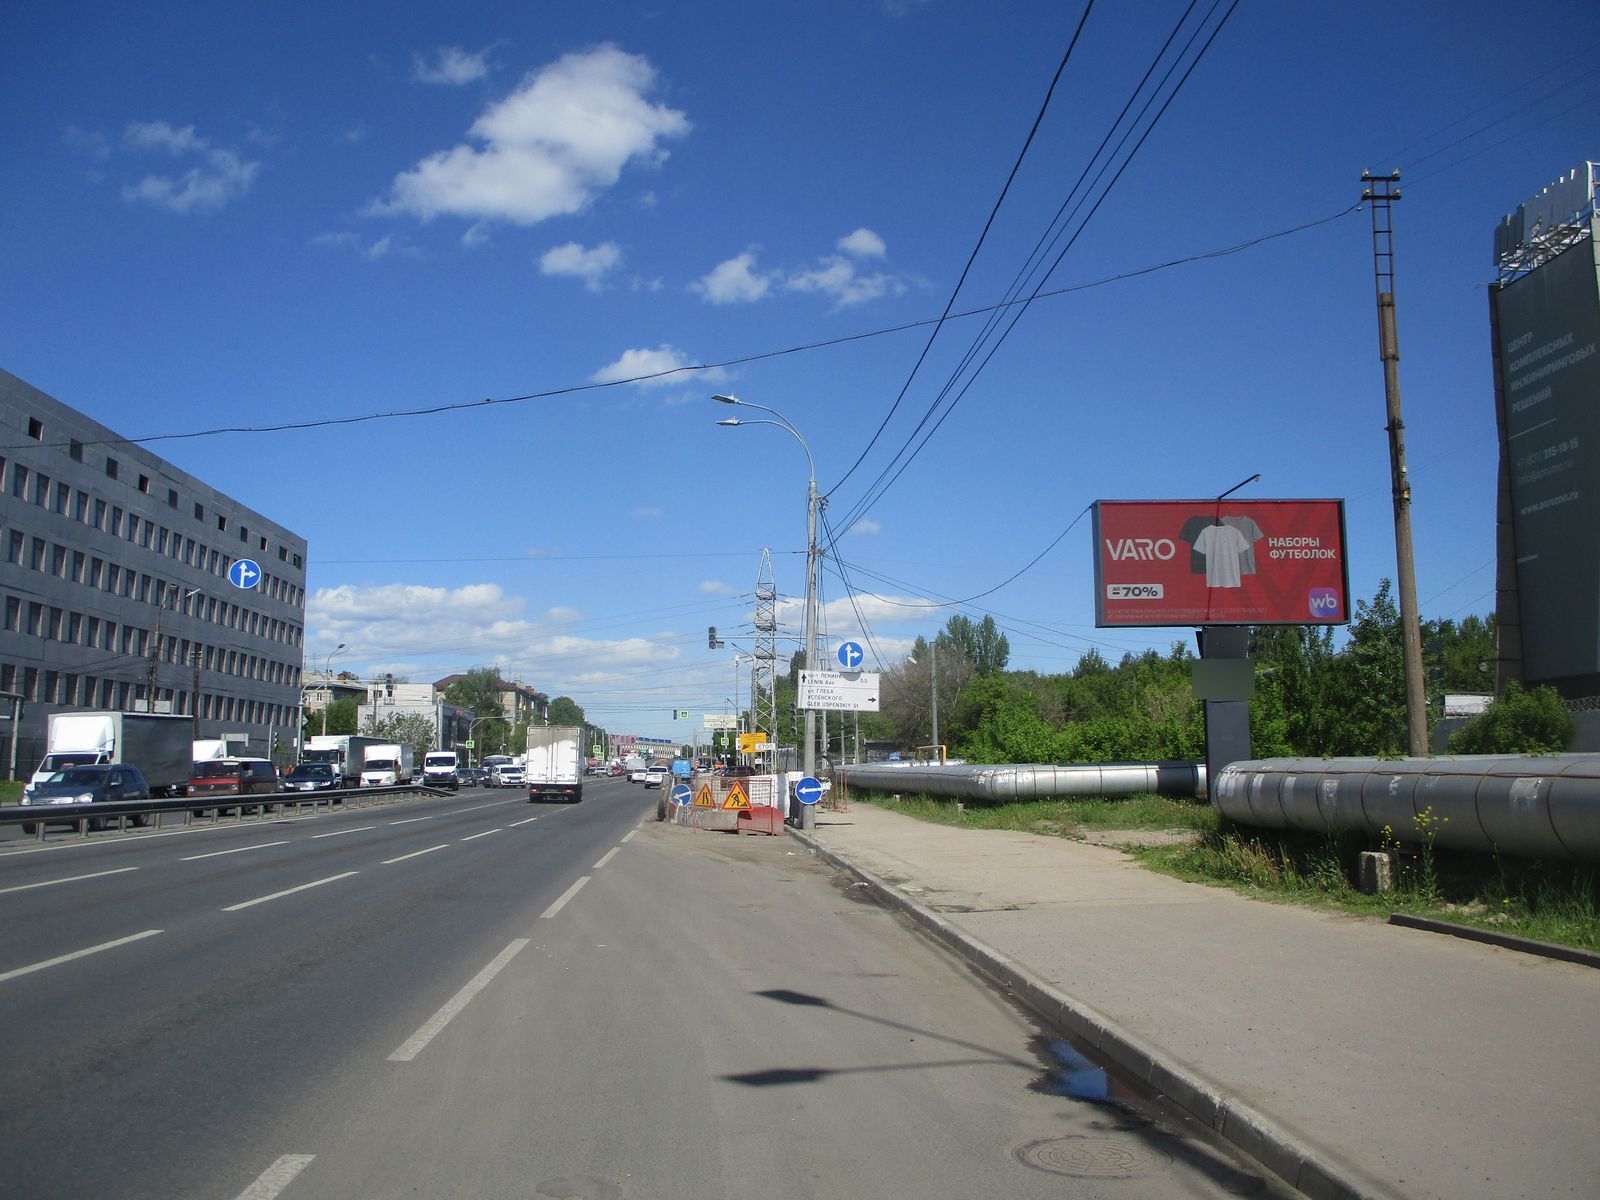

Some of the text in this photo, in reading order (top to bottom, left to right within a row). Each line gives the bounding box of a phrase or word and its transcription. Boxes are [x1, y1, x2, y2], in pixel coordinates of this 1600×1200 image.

[1507, 331, 1533, 353] ЦЕНТР
[1509, 332, 1574, 374] КОМПЛЕКСНЫХ
[1512, 385, 1552, 414] РЕШЕНИЙ
[1268, 537, 1320, 548] НАБОРЫ
[1269, 549, 1337, 560] ФУТБОЛОК
[1311, 592, 1337, 609] wb
